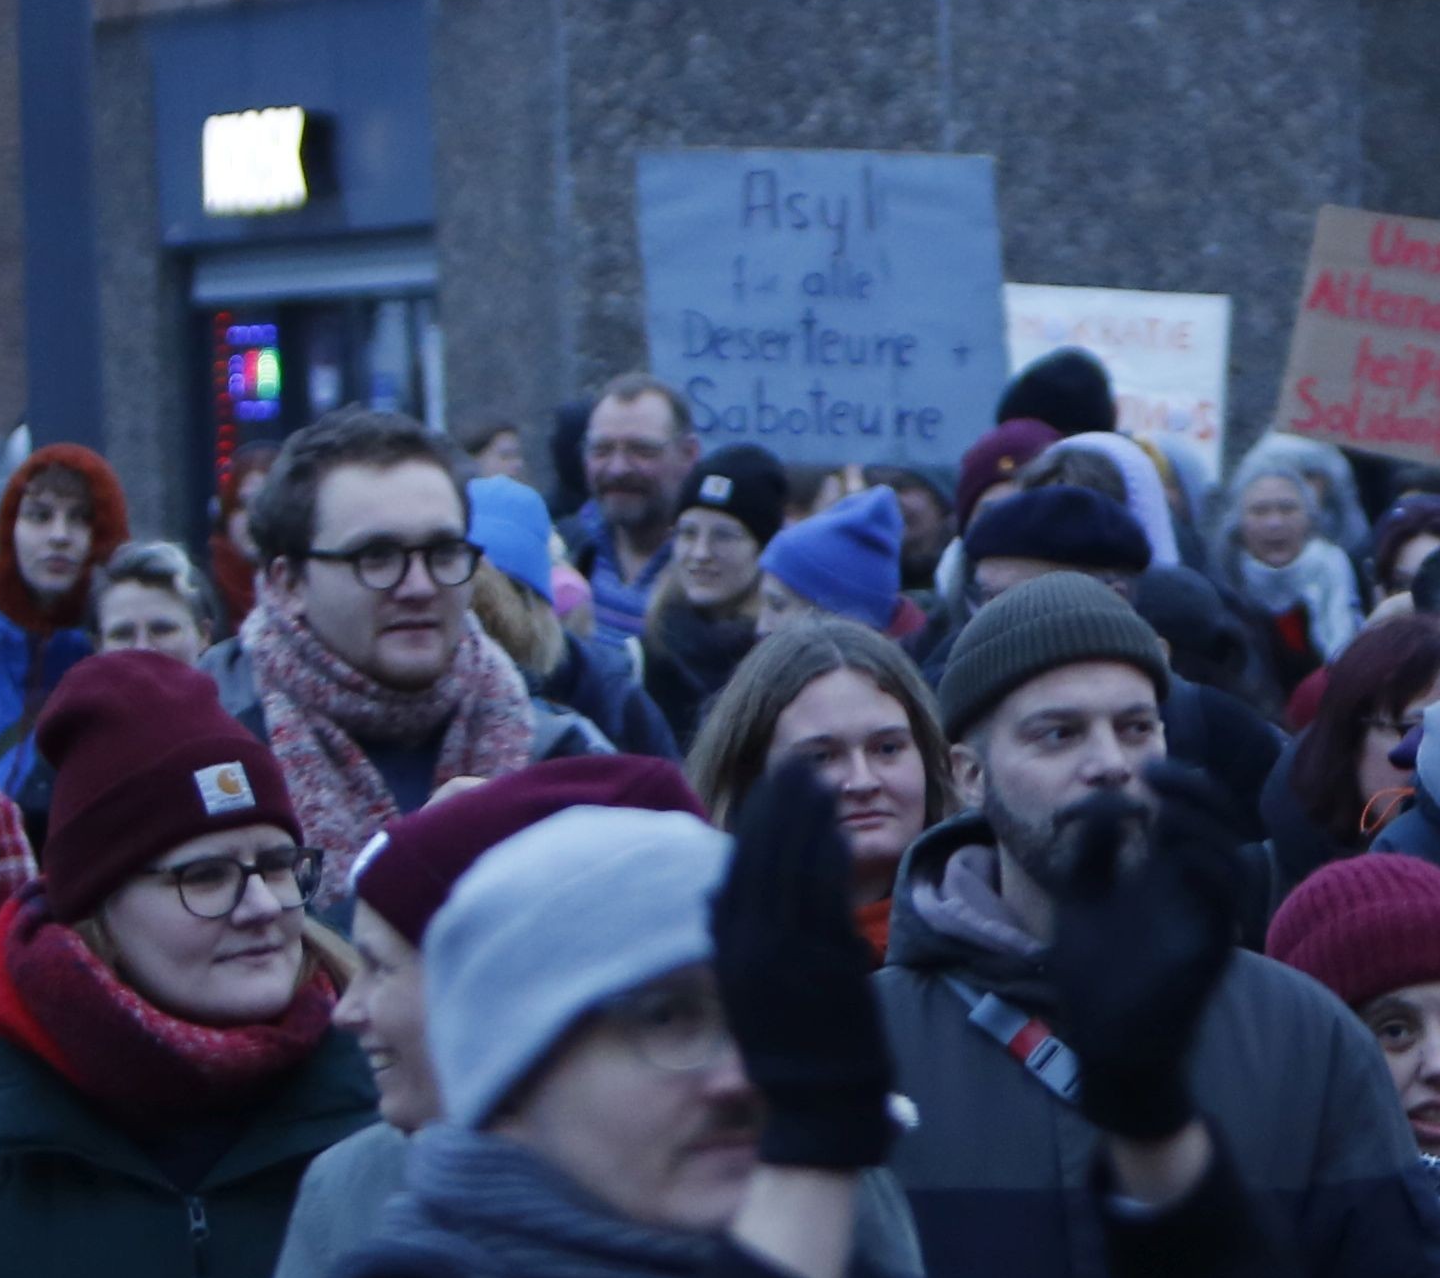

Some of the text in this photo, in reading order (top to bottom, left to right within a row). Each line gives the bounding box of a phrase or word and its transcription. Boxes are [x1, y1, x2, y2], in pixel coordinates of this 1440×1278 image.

[742, 166, 876, 256] Asyl
[681, 307, 919, 367] Deserteure
[685, 376, 944, 441] Saboteure
